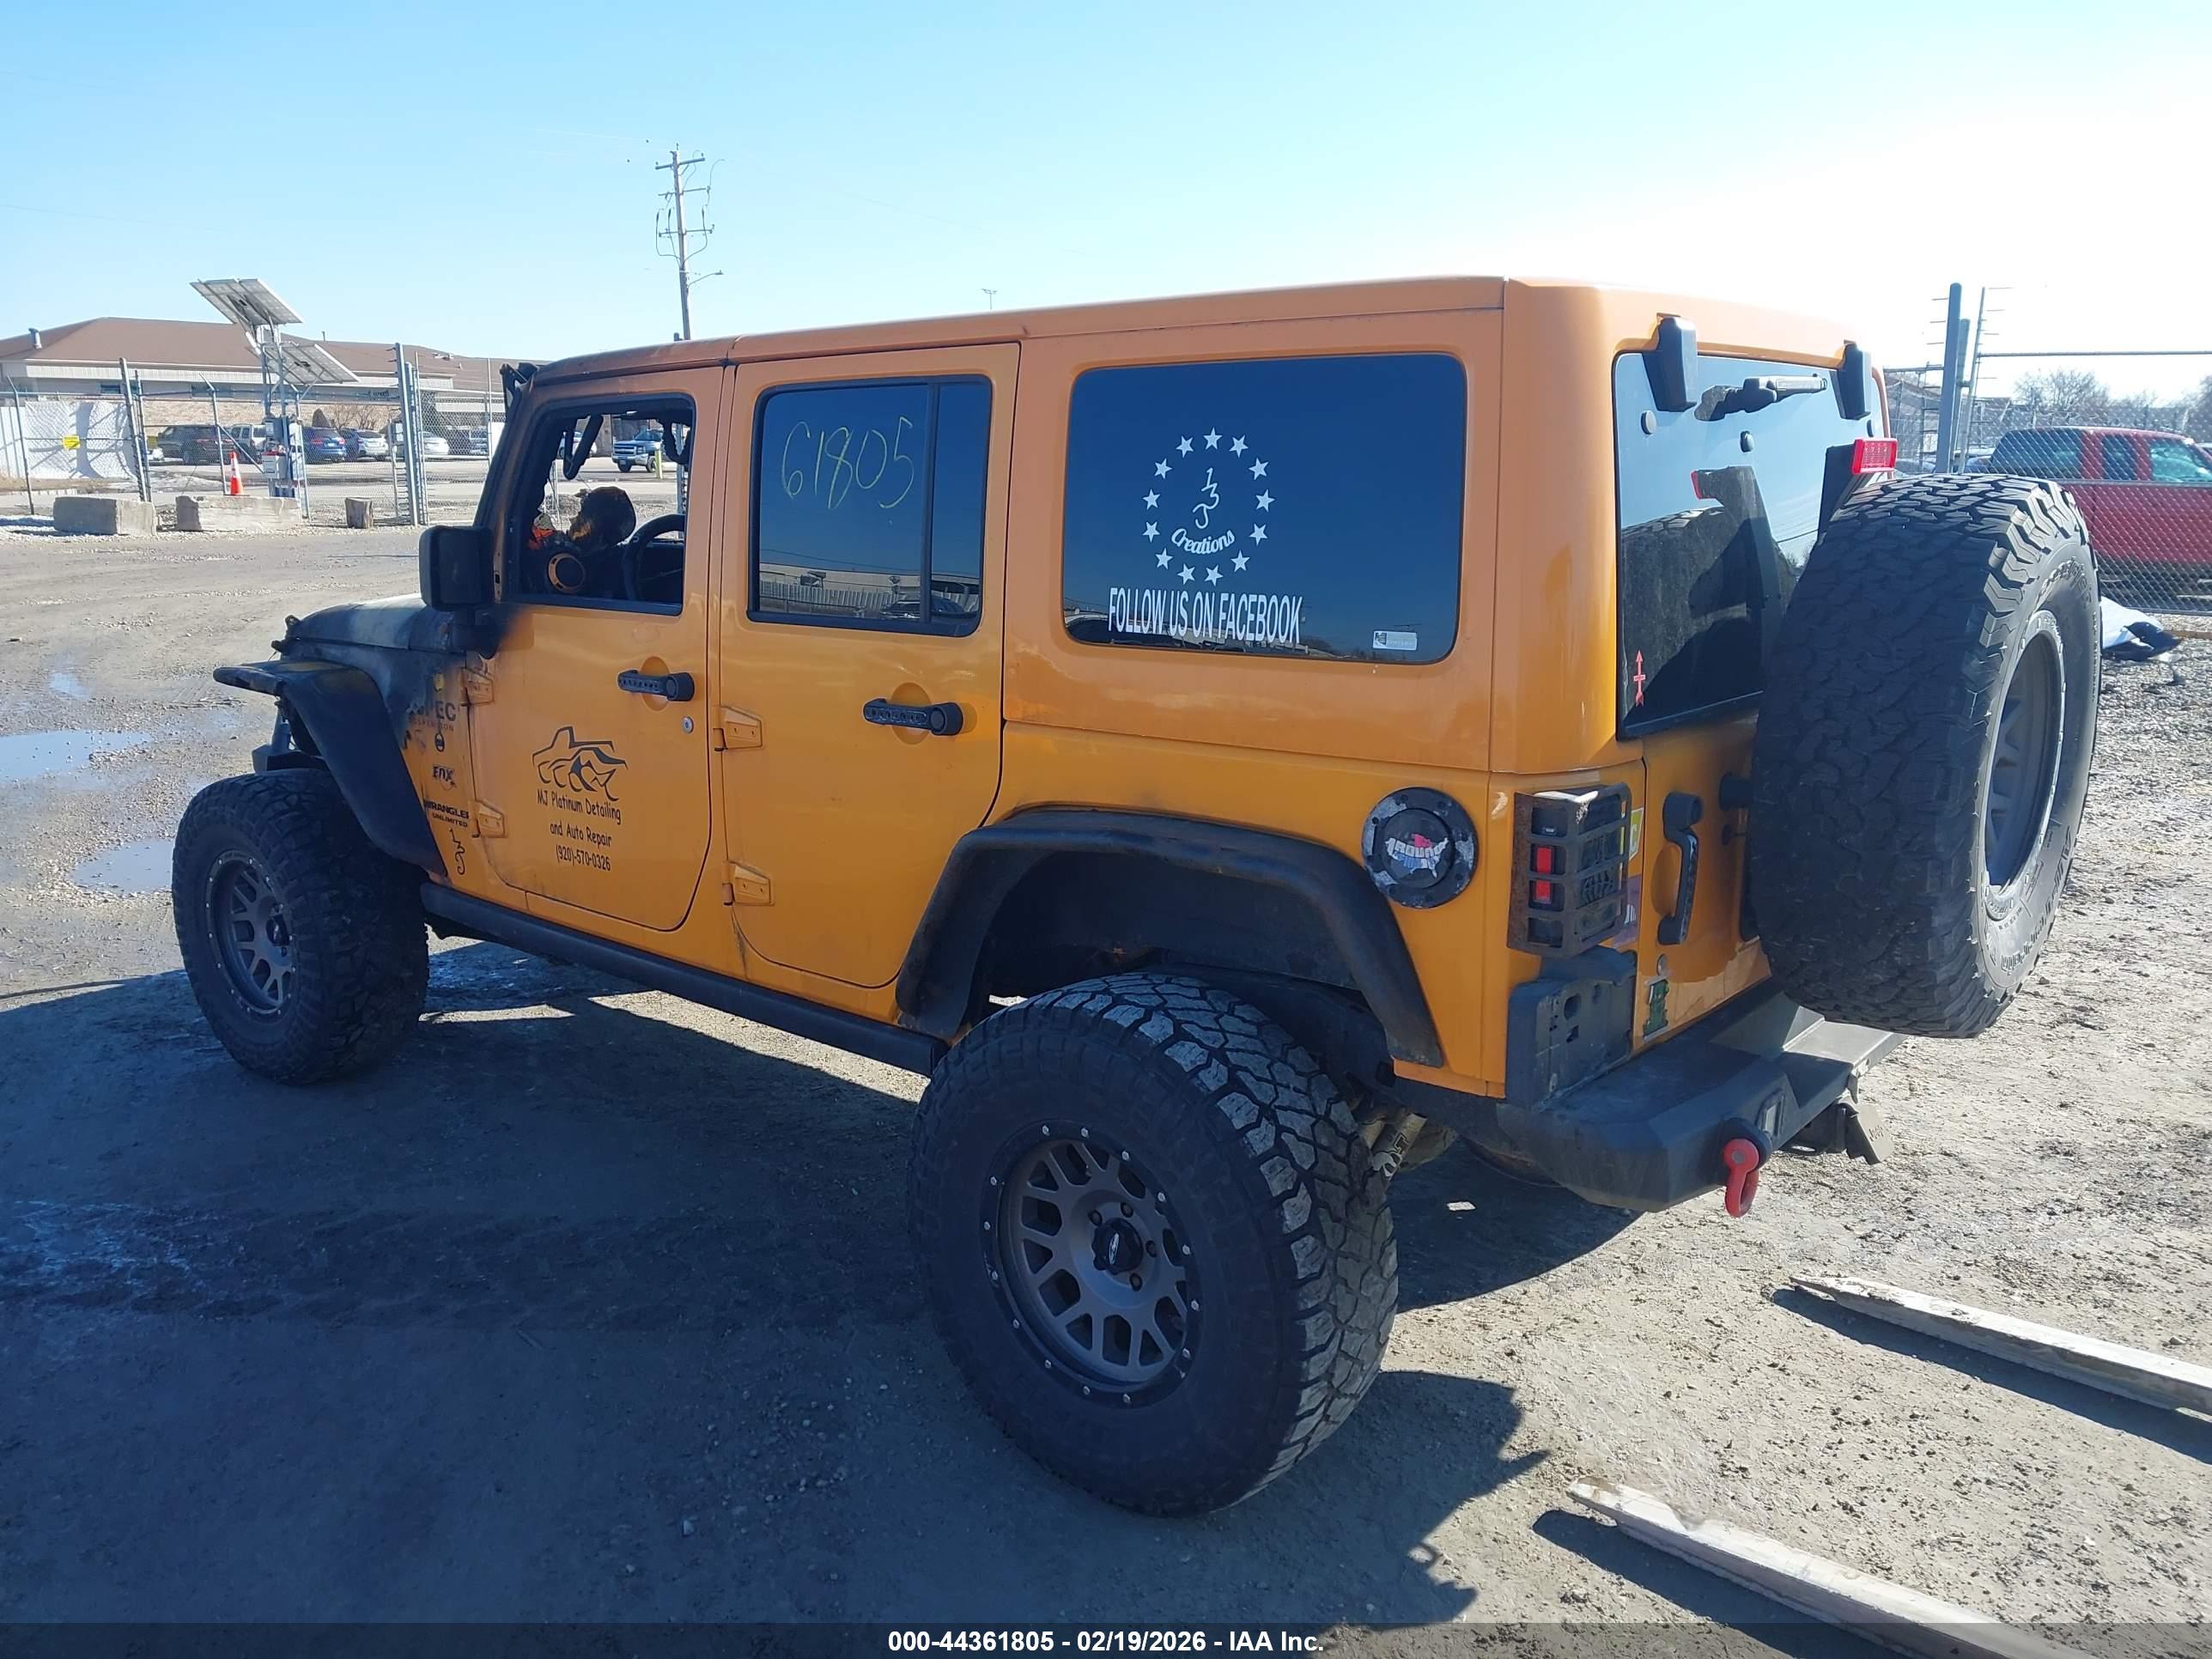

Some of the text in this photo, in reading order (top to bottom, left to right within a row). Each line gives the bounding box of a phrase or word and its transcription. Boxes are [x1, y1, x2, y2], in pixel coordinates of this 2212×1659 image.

[781, 416, 915, 509] 61805
[1170, 527, 1236, 555] Creations
[1109, 586, 1304, 645] FOLLOW US ON FACEBOOK
[432, 813, 468, 828] UNLIMITED
[537, 788, 622, 825] MJ Platinum Detailing
[550, 820, 612, 848] and Auto Repair
[556, 844, 611, 872] (920)-570-0326
